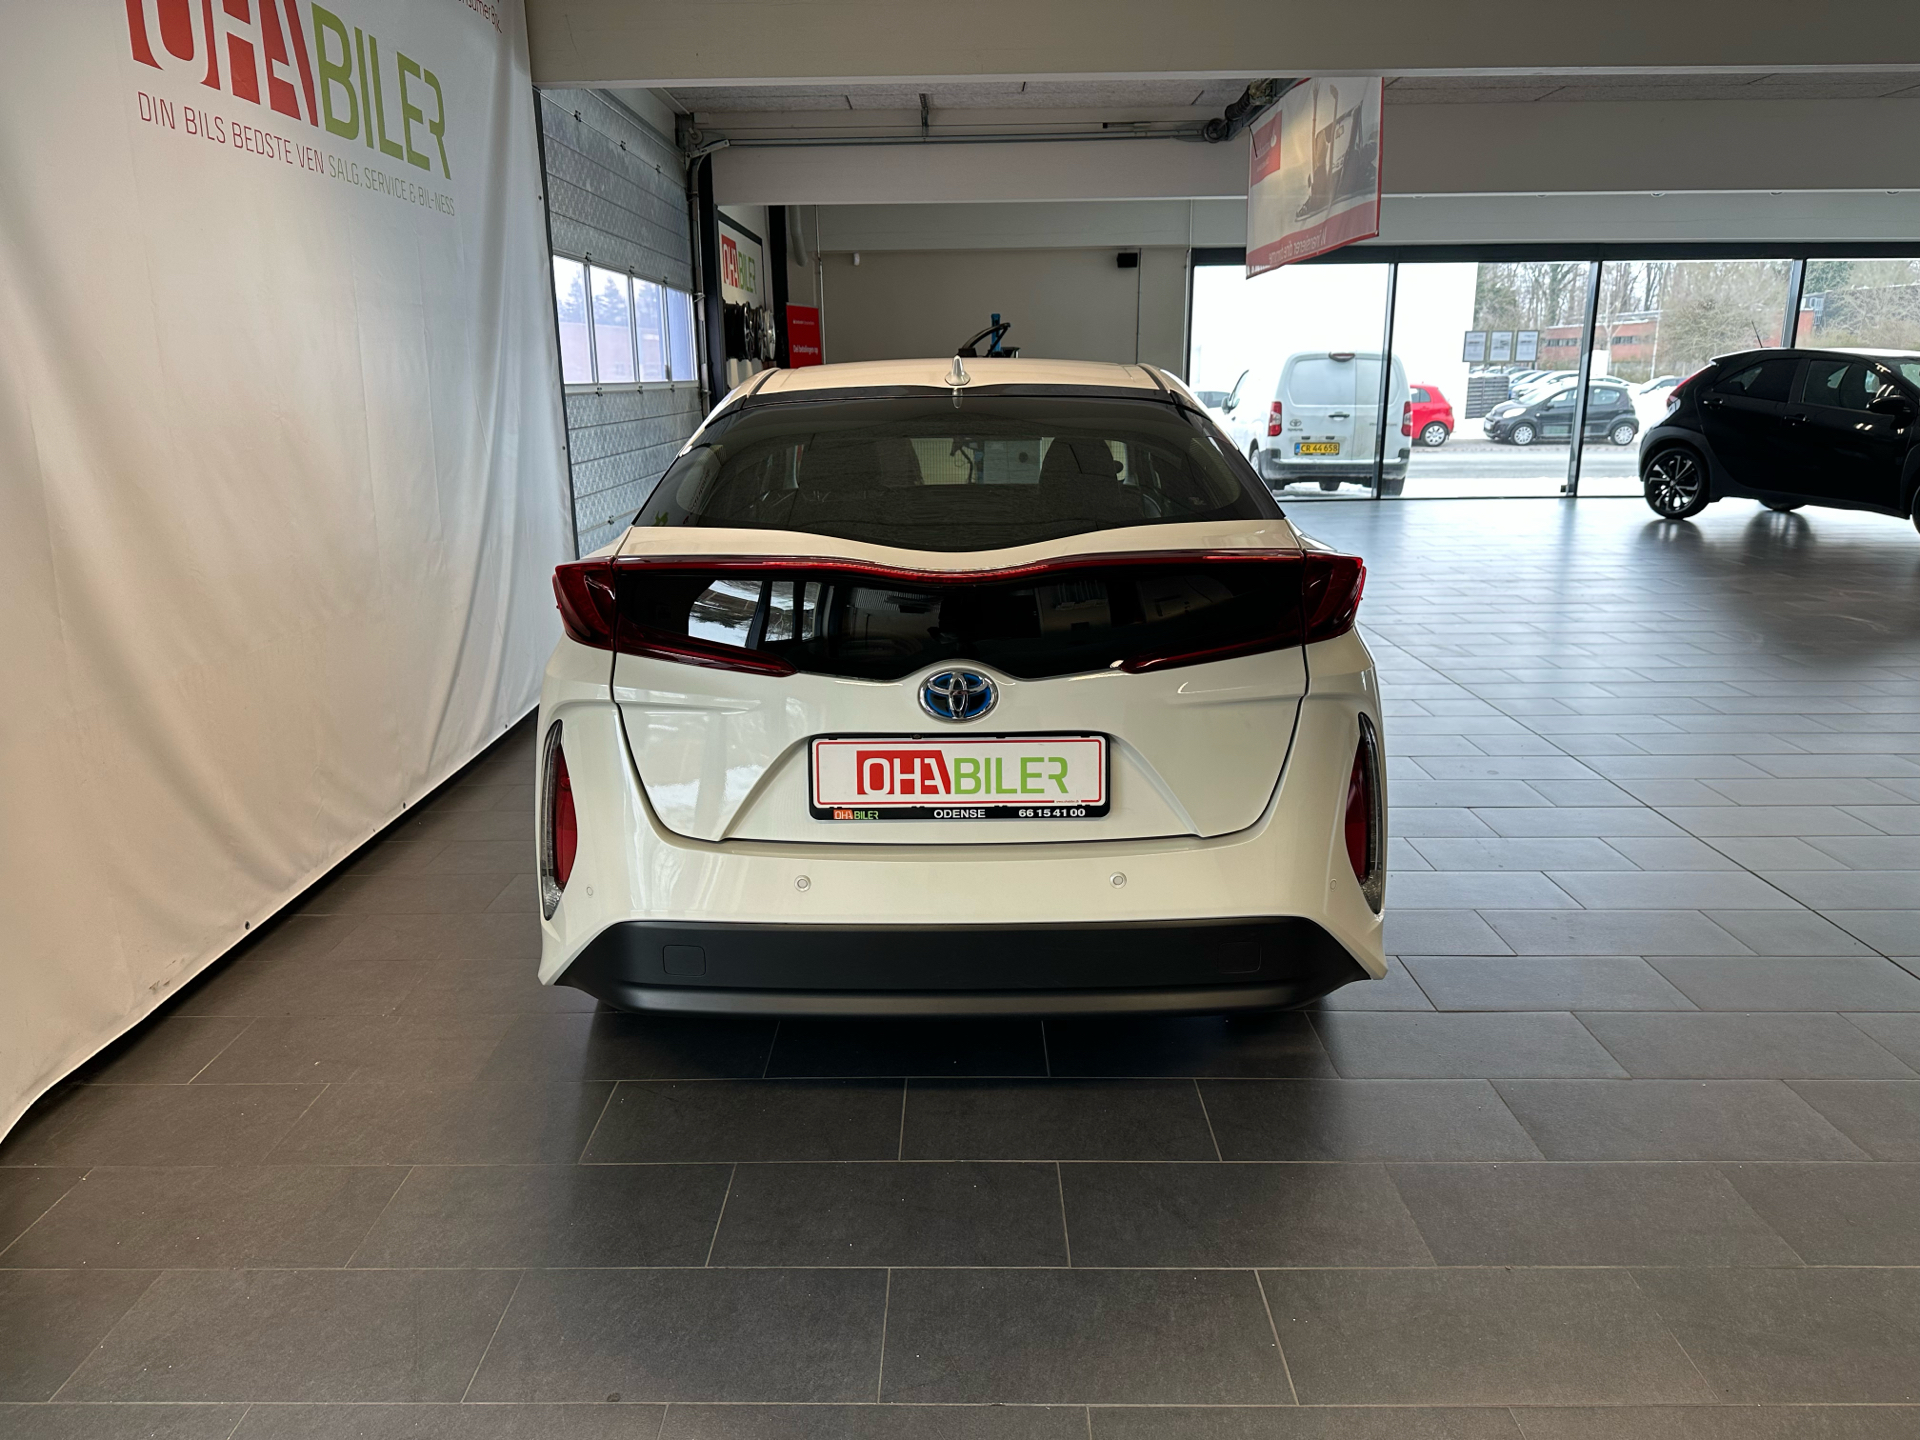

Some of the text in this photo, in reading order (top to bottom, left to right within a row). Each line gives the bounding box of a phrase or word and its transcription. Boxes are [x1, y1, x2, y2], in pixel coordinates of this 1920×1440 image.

[138, 91, 175, 129] DIN
[184, 106, 226, 144] BILS
[232, 122, 293, 165] BEDSTE
[296, 143, 325, 174] VEN
[364, 167, 408, 201] SERVICE
[409, 183, 416, 203] &
[418, 186, 455, 216] BIL-NESS
[934, 809, 986, 818] ODENSE
